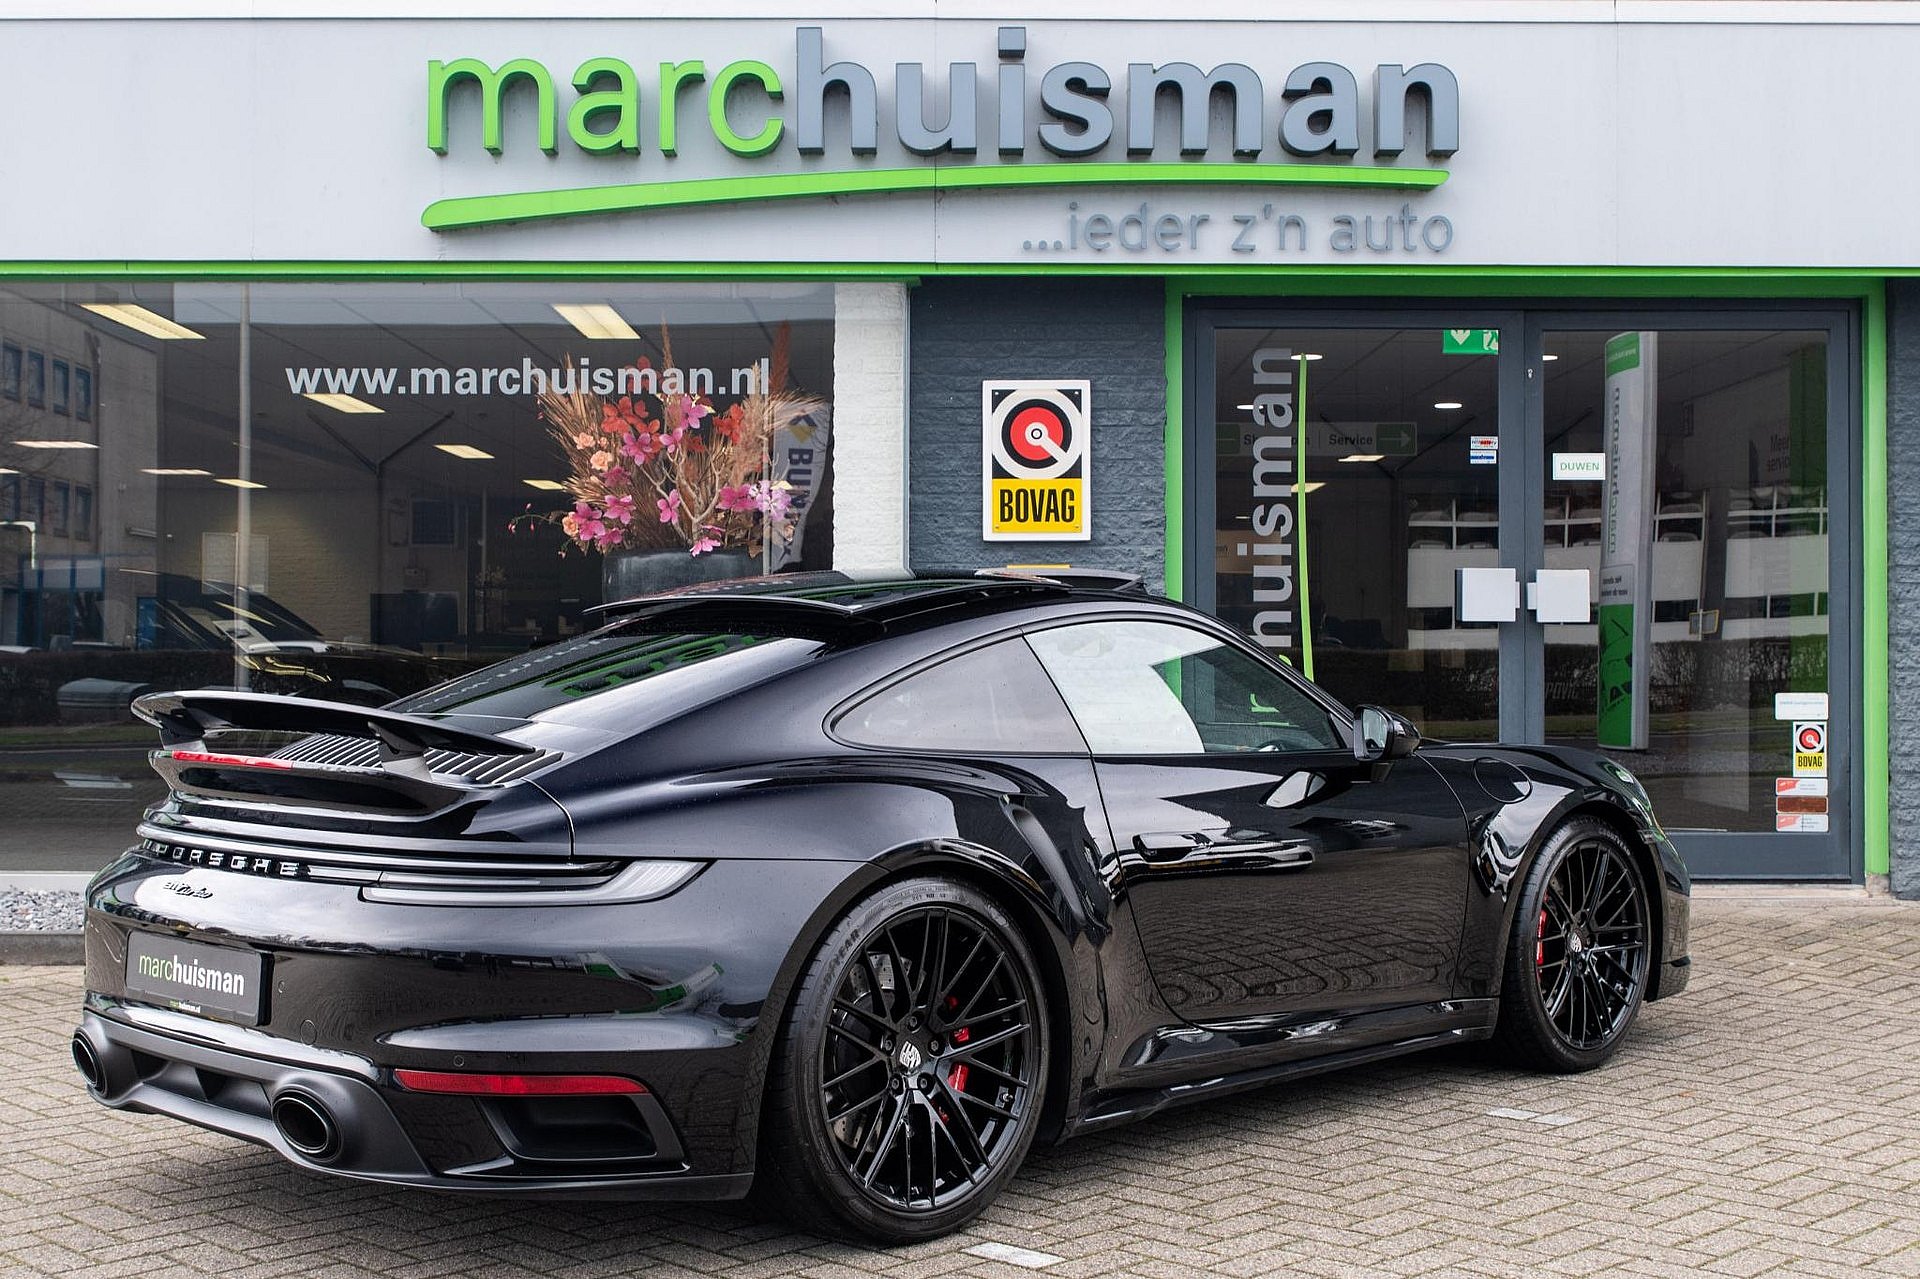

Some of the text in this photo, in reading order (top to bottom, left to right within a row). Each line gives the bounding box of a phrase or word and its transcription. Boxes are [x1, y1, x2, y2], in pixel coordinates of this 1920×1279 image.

[427, 26, 1460, 158] marchuisman
[1231, 203, 1308, 252] z'n
[1329, 203, 1454, 252] auto
[285, 357, 770, 396] www.marchuisman.nl
[1328, 433, 1373, 446] Service
[1560, 462, 1600, 471] DUWEN
[1000, 488, 1075, 523] BOVAG
[1797, 756, 1823, 768] BOVAG
[151, 841, 300, 877] PORSCHE
[139, 954, 245, 996] marchuisman
